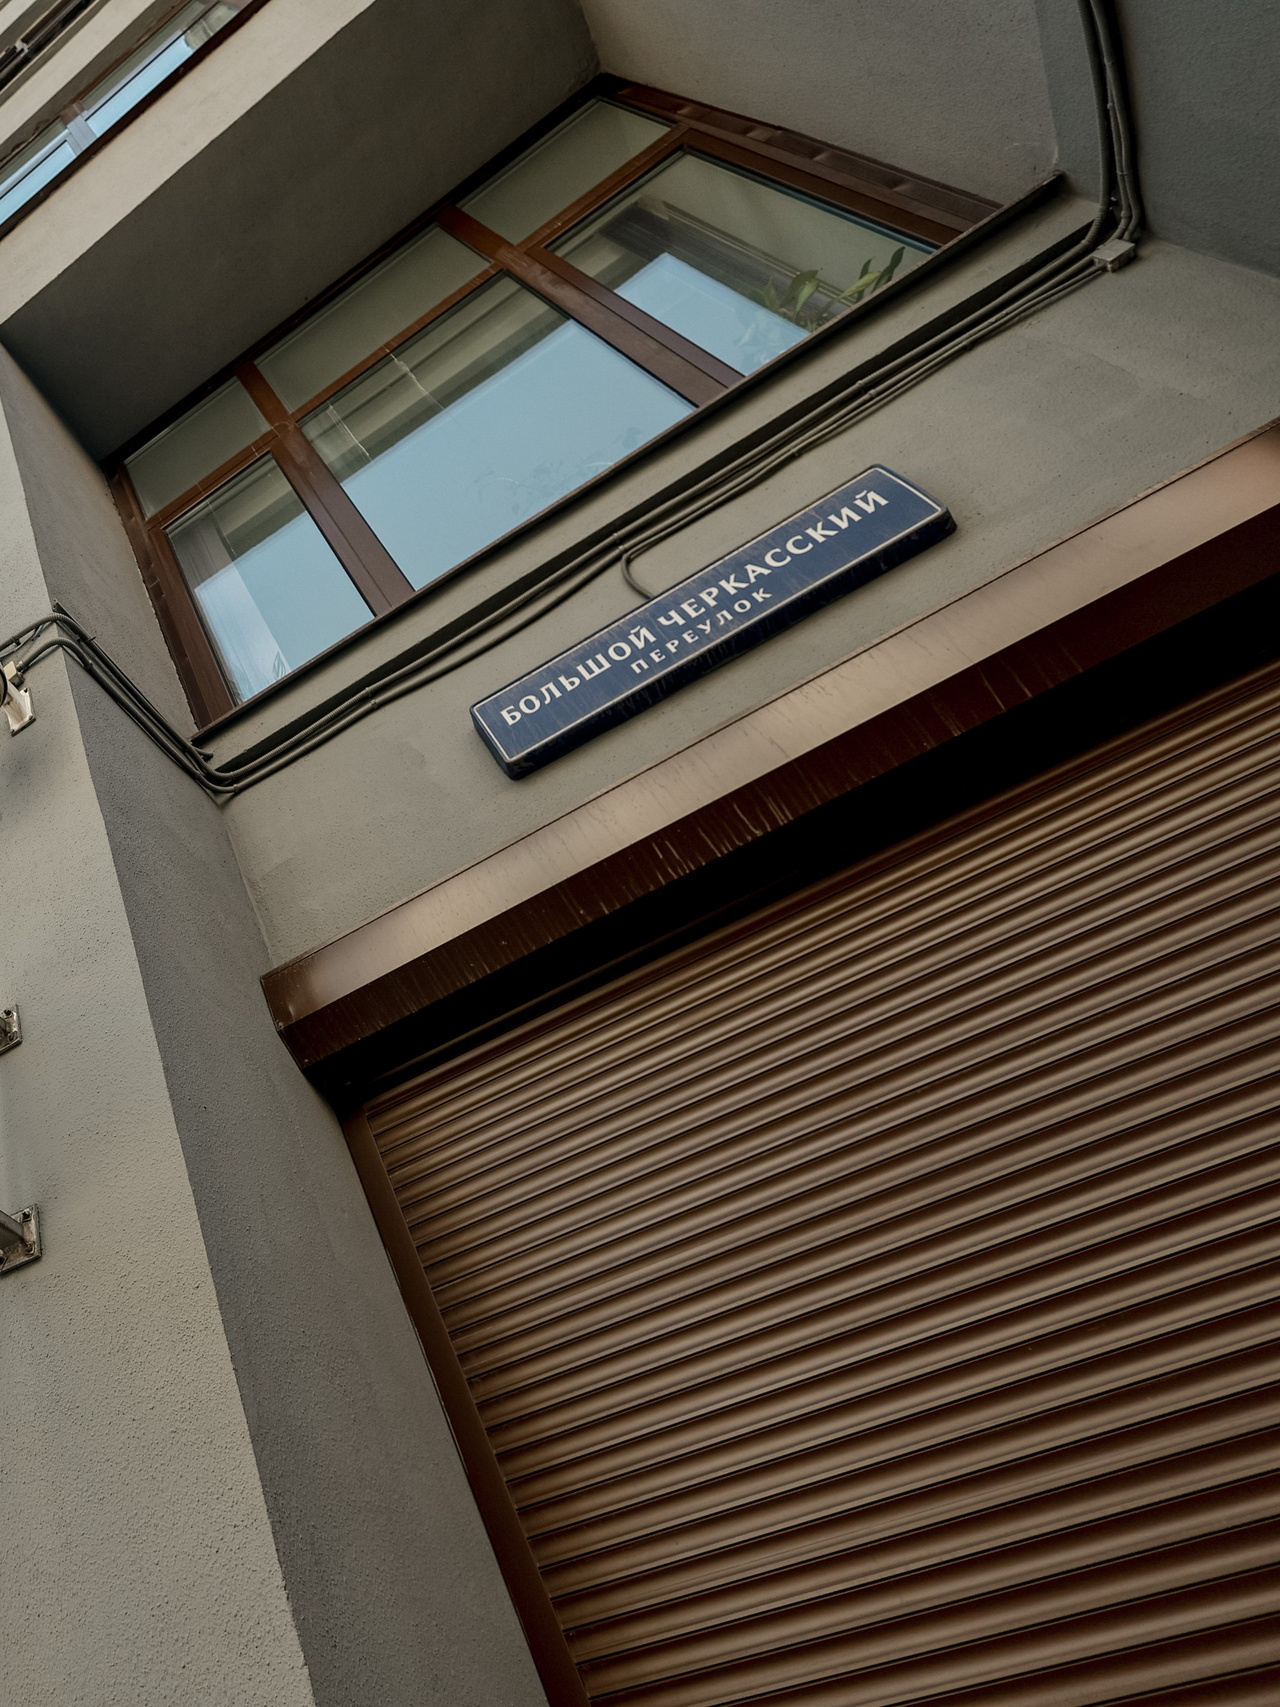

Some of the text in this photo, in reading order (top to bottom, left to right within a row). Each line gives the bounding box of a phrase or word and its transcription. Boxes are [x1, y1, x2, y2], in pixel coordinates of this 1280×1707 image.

[499, 488, 889, 727] БОЛЬШОЙ ЧЕРКАССКИЙ
[630, 587, 773, 674] ПЕРЕУЛОК
